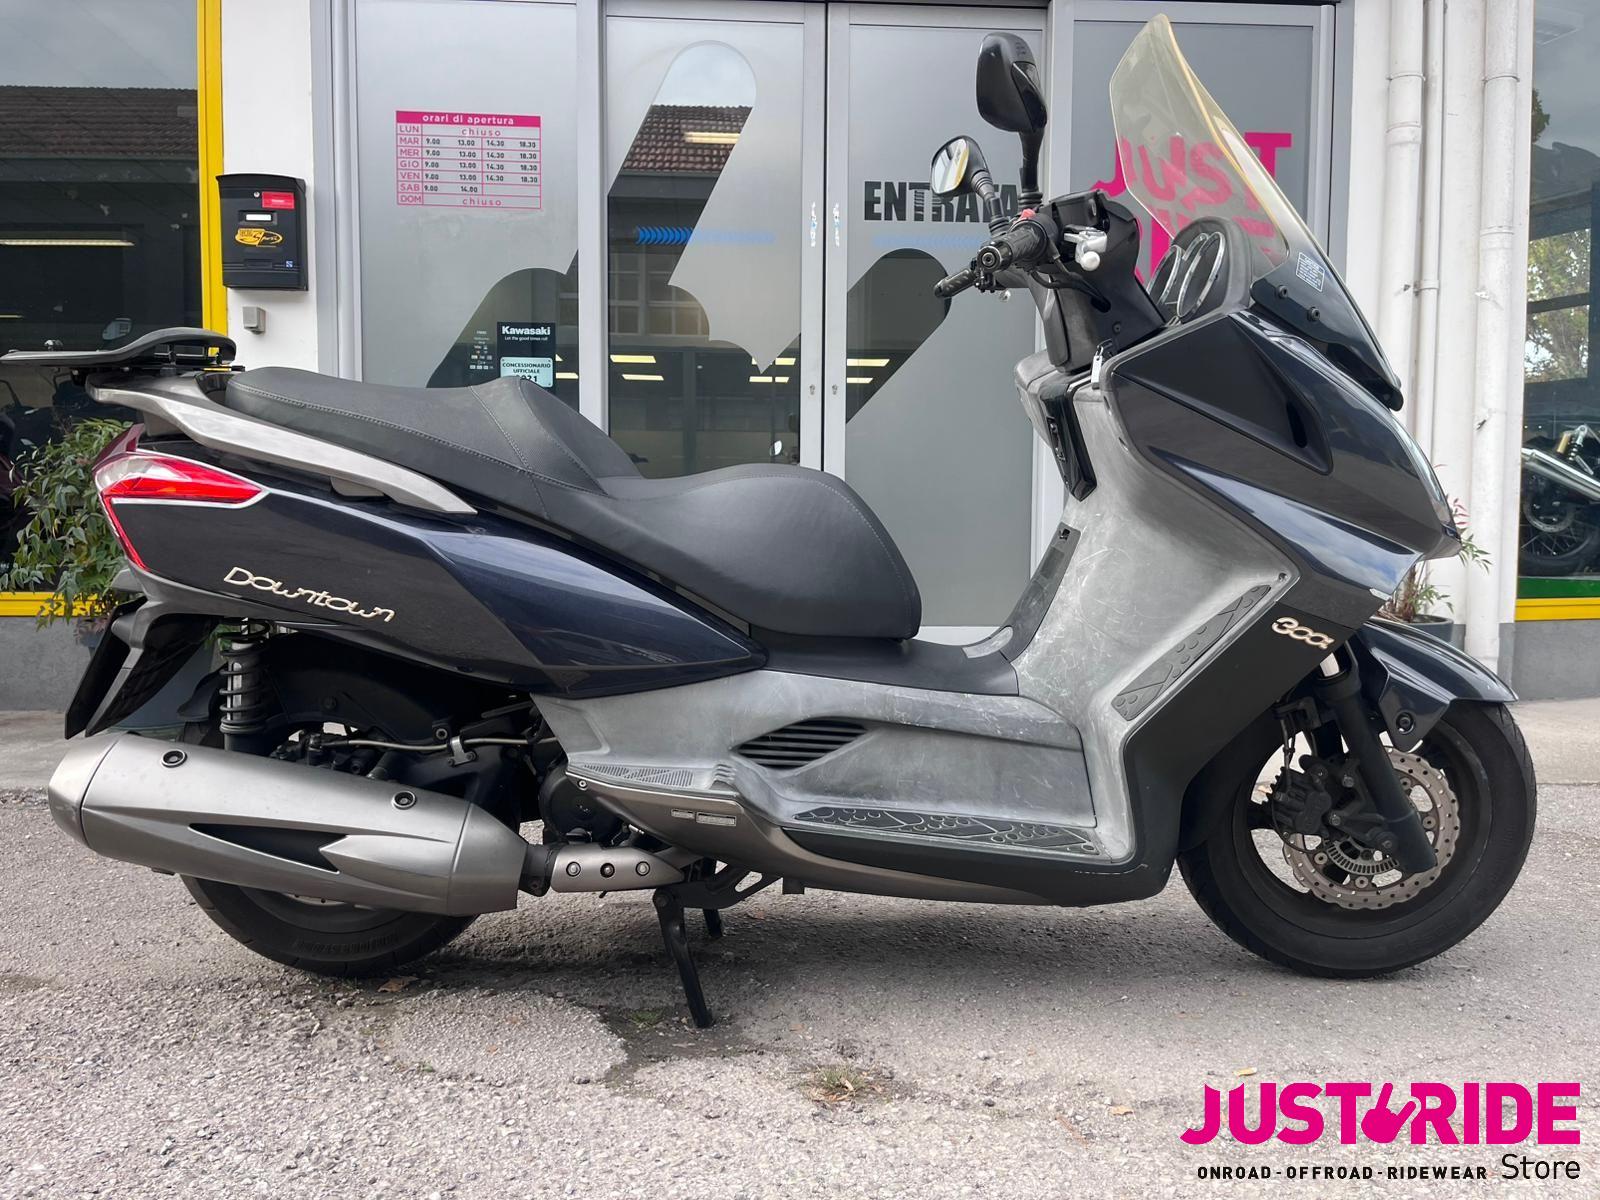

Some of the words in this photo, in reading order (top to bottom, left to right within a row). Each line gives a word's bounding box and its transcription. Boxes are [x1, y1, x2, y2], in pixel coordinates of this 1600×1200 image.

[422, 114, 449, 123] orari
[452, 115, 463, 123] di
[467, 116, 514, 125] apertura
[399, 125, 420, 133] LUN
[461, 128, 501, 136] chiuso
[399, 137, 420, 145] MAR
[400, 160, 420, 168] GIO
[400, 172, 421, 180] VEN
[400, 183, 420, 192] SAB
[400, 195, 422, 203] DOM
[462, 197, 502, 206] chiuso
[501, 325, 551, 336] Kawasaki
[223, 566, 396, 623] Downtown
